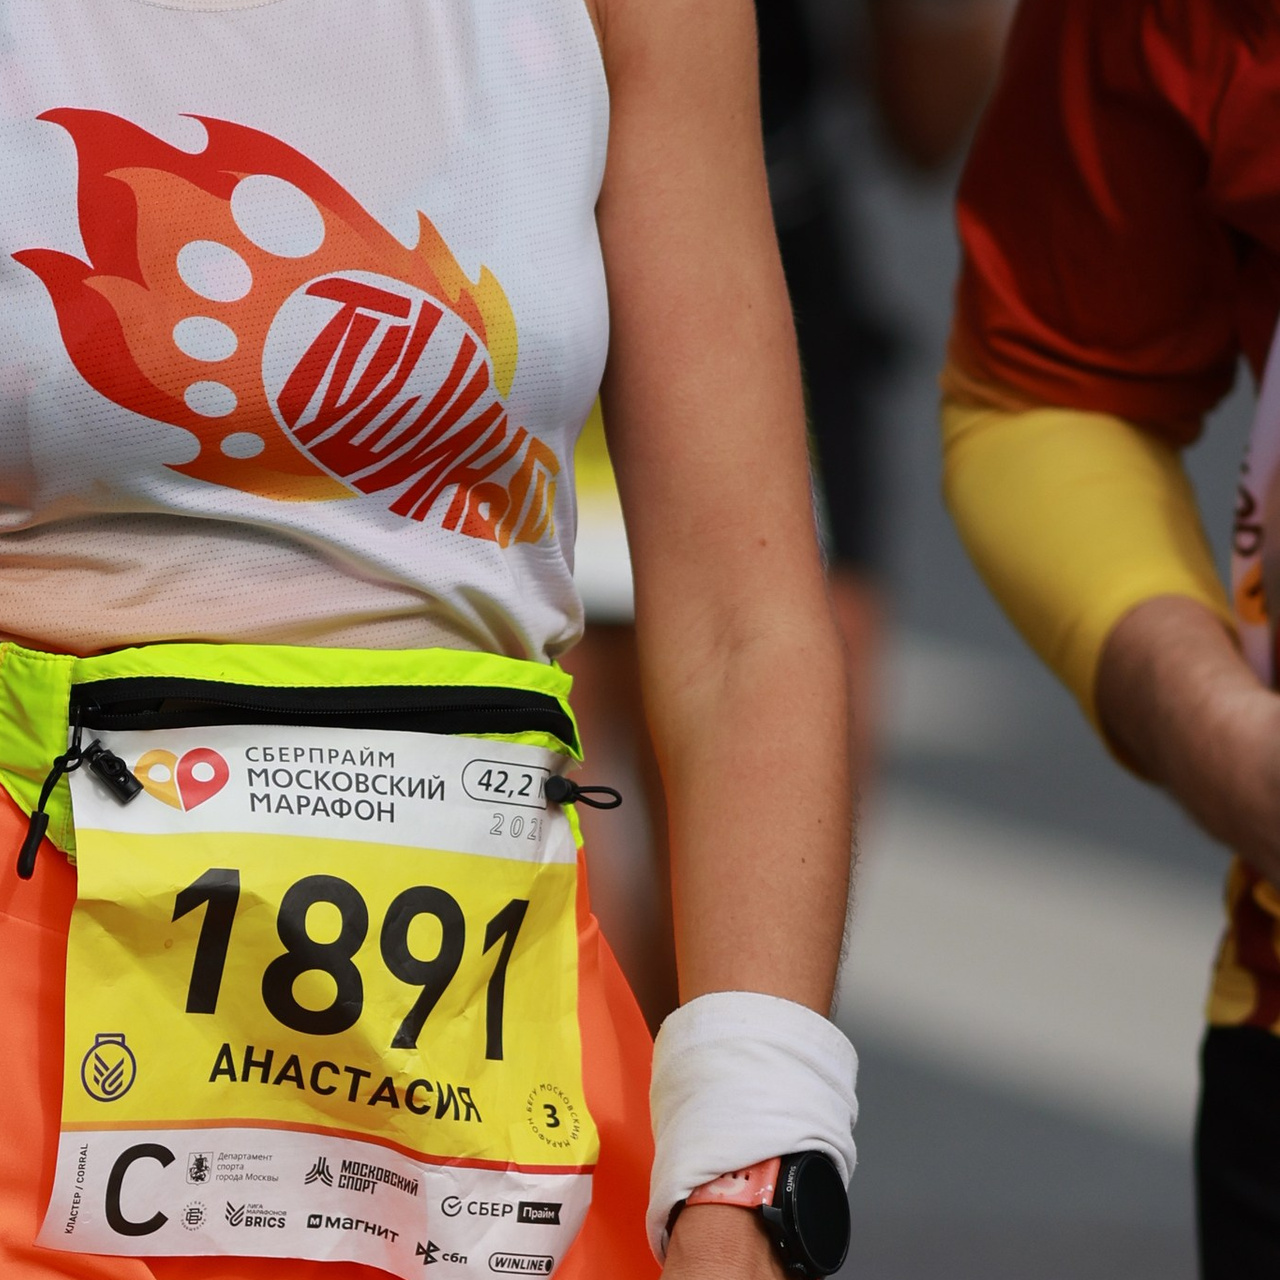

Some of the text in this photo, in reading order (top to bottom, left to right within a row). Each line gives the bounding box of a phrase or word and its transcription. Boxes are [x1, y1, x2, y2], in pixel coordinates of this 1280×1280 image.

[245, 746, 395, 768] СБЕРПРАЙМ
[247, 768, 445, 801] МОСКОВСКИЙ
[477, 769, 533, 798] 42,2
[249, 792, 395, 823] МАРАФОН
[489, 812, 543, 842] 202
[171, 867, 530, 1061] 1891
[208, 1043, 483, 1122] АНАСТАСИЯ
[539, 1083, 580, 1140] МОСКОВСКИЙ
[542, 1103, 561, 1129] 3
[527, 1116, 571, 1148] МАРАФОН
[216, 1163, 245, 1172] спорта
[217, 1152, 273, 1162] Департамент
[64, 1192, 82, 1234] КЛАСТЕР
[76, 1143, 89, 1184] CORRAL
[105, 1142, 176, 1237] C
[215, 1173, 279, 1182] города Москвы
[338, 1174, 378, 1195] СПОРТ
[340, 1159, 419, 1196] МОСКОВСКИЙ
[785, 1166, 797, 1193] SUUNTO
[245, 1216, 286, 1228] BRICS
[467, 1201, 555, 1220] СБЕР Прайм
[325, 1216, 399, 1243] магнит
[441, 1252, 468, 1264] сбп
[495, 1256, 545, 1271] WINLINE
